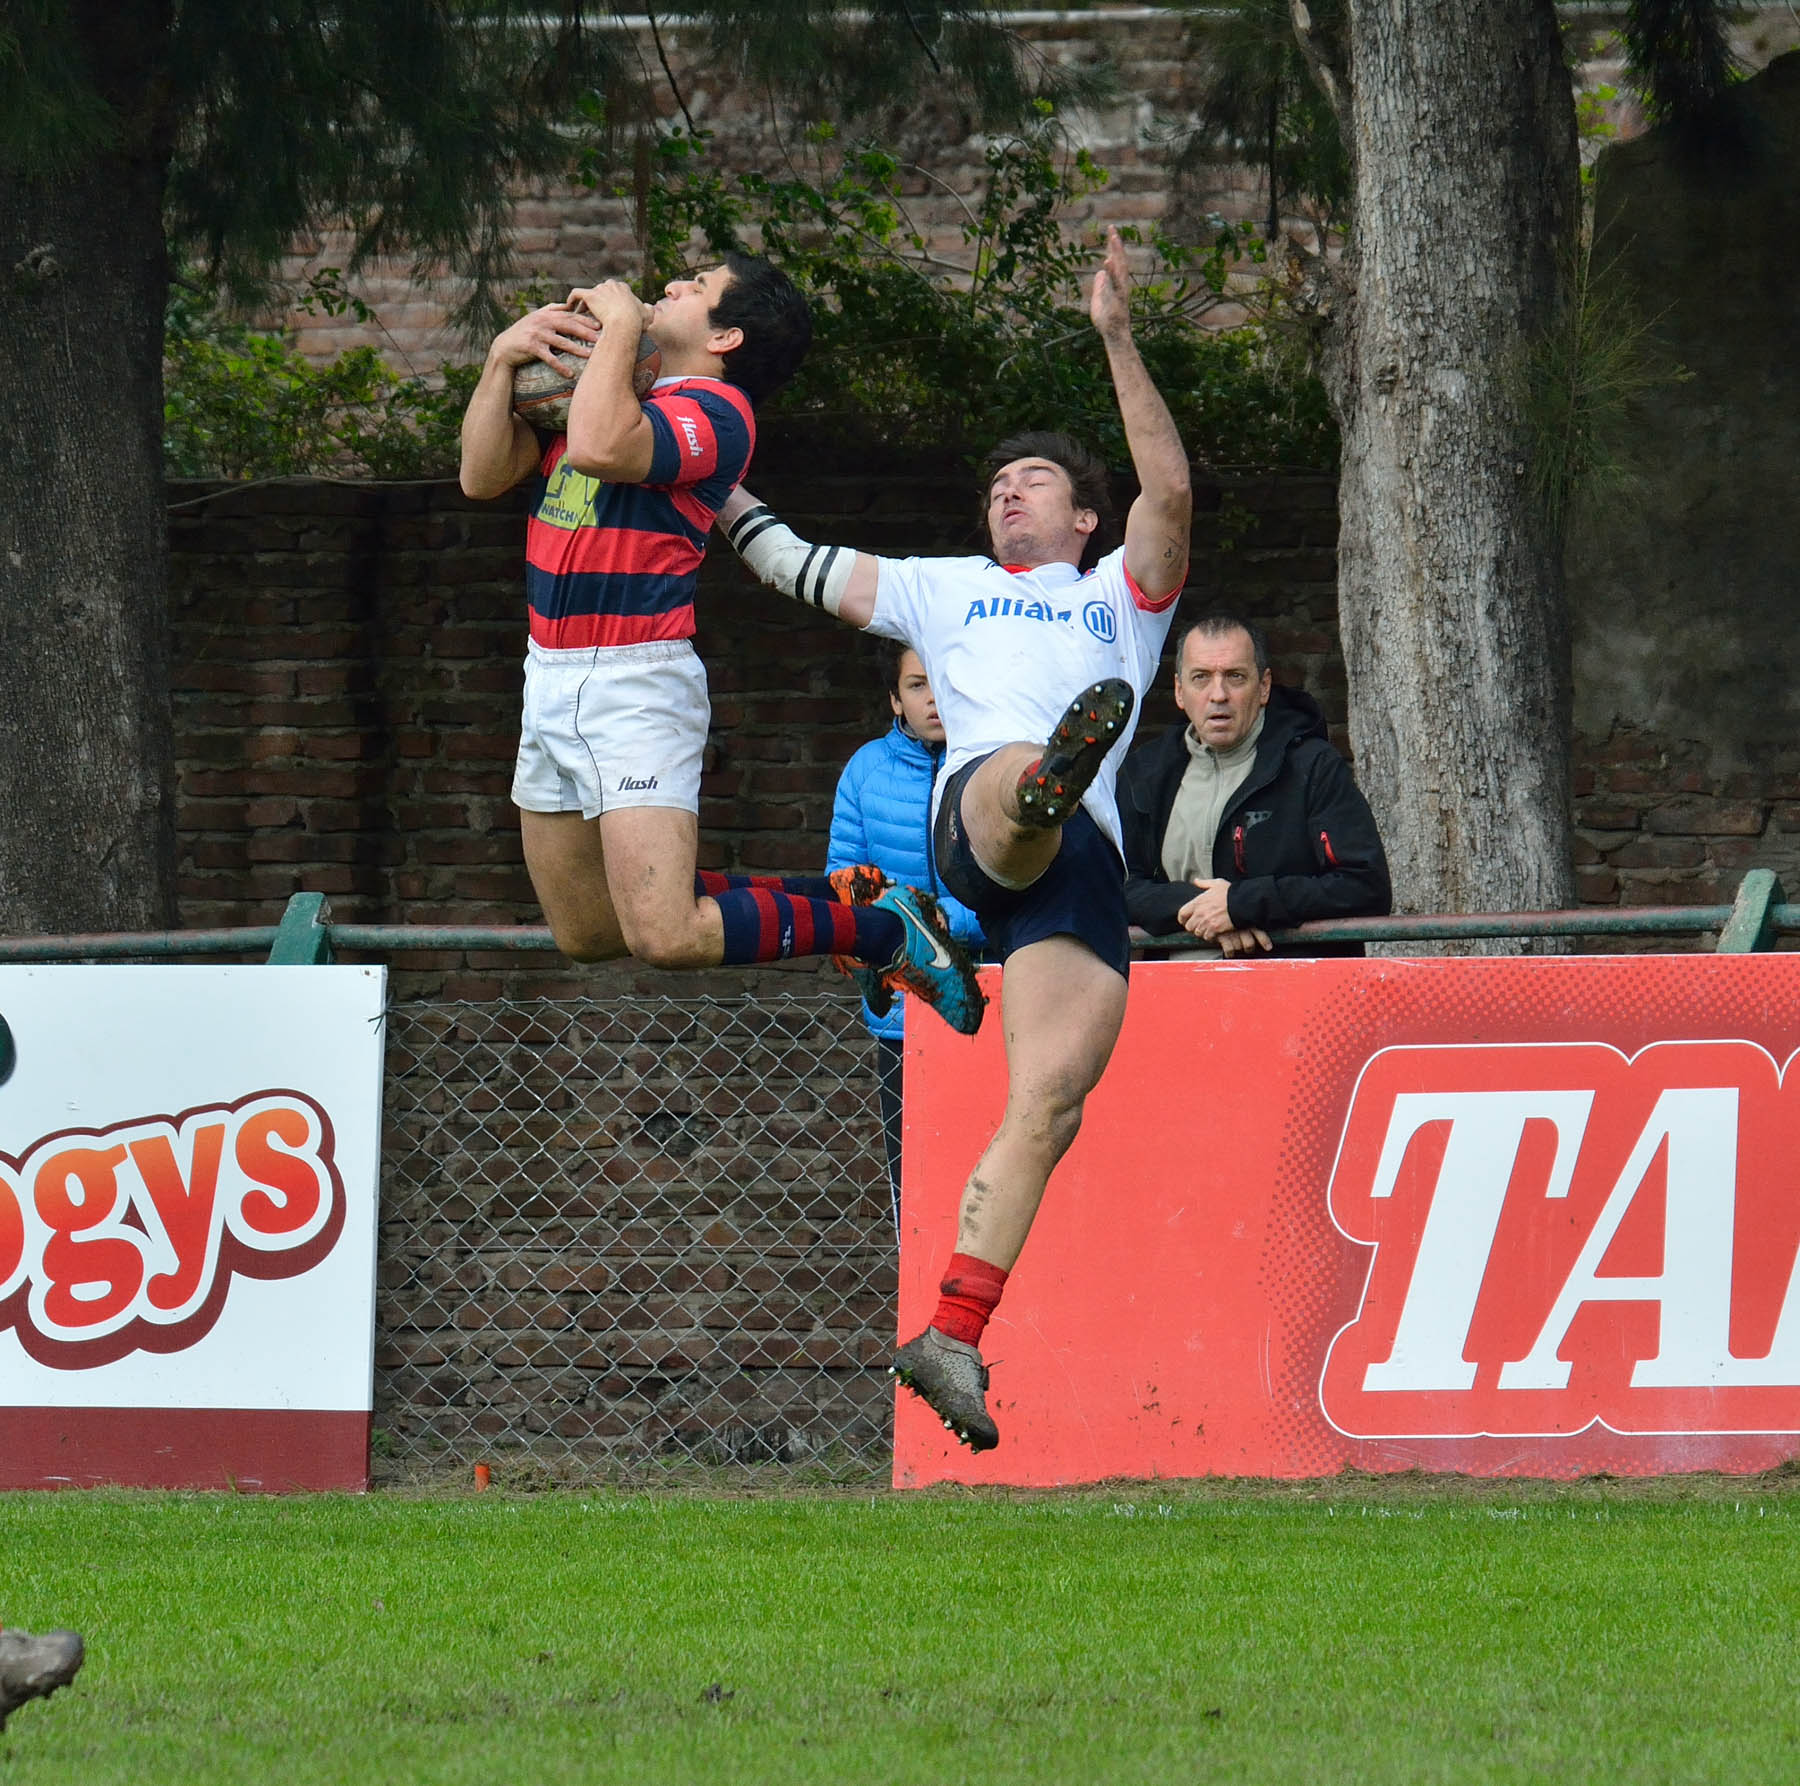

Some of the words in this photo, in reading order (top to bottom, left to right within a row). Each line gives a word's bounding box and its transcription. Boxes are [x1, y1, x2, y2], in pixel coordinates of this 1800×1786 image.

[675, 415, 704, 457] flash
[617, 775, 658, 791] flash
[1361, 1088, 1800, 1392] TA
